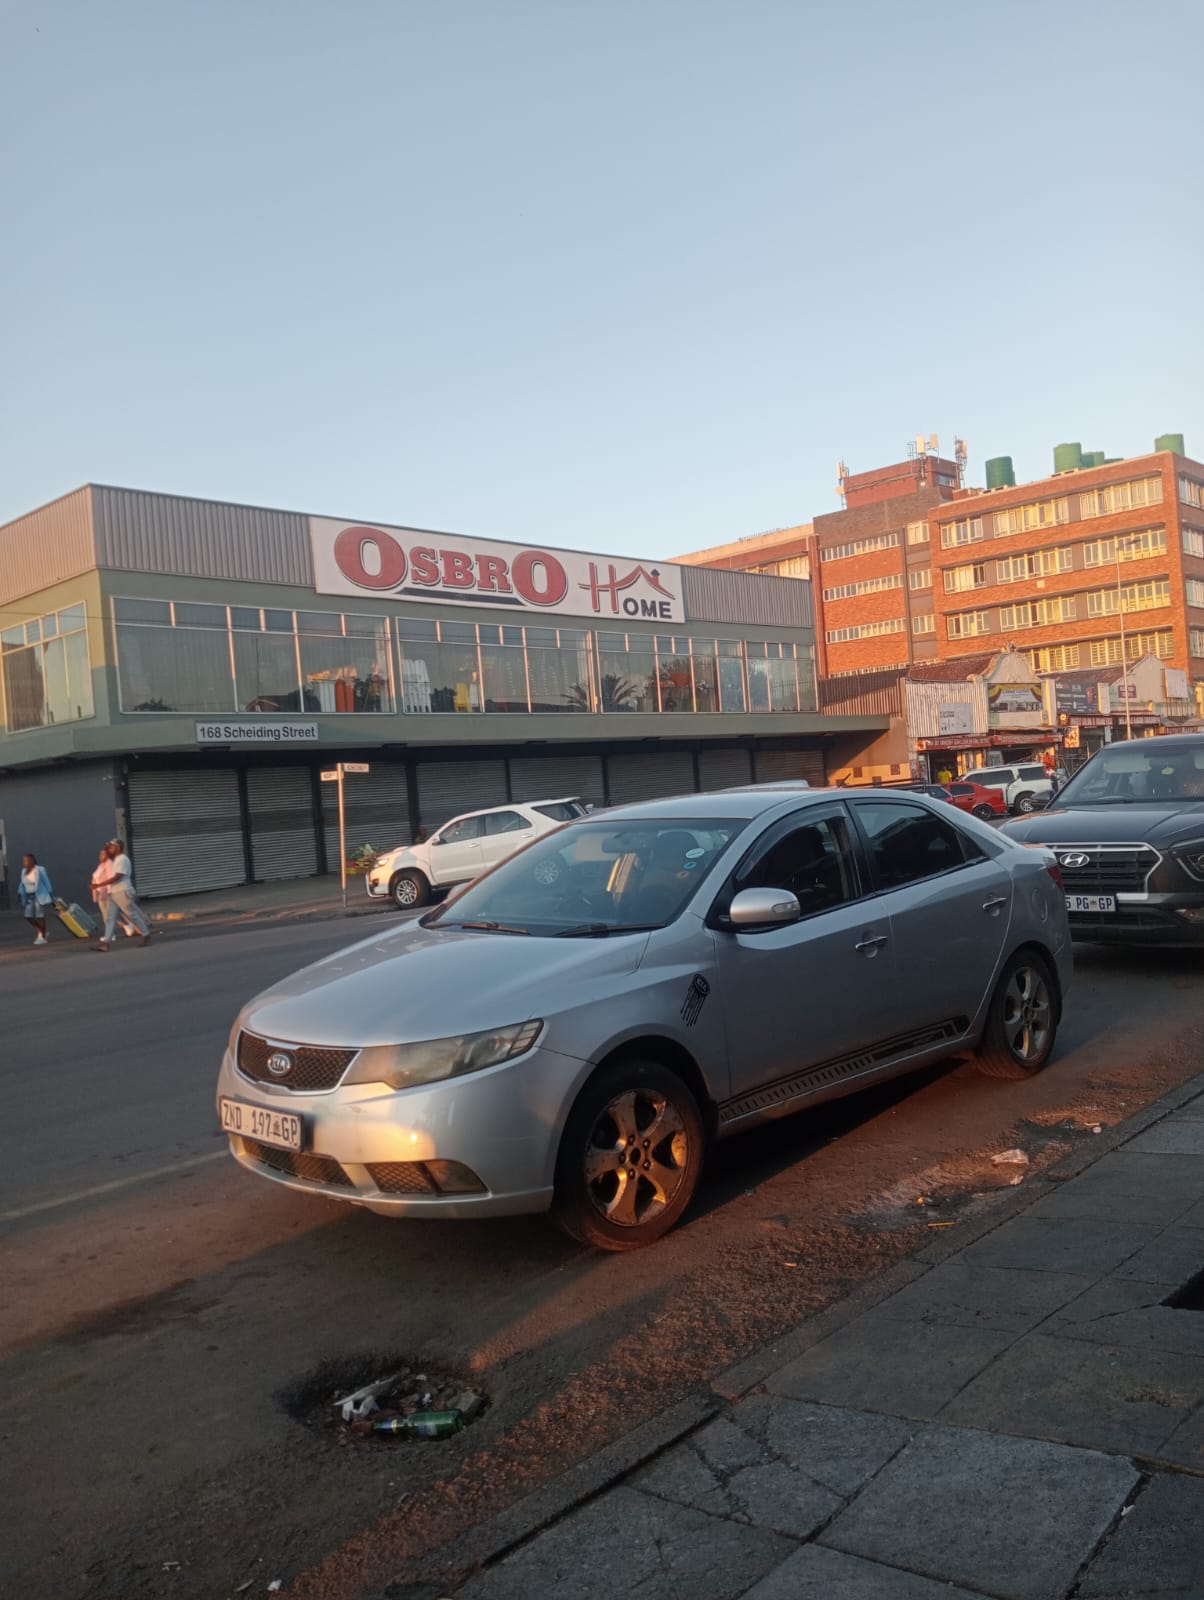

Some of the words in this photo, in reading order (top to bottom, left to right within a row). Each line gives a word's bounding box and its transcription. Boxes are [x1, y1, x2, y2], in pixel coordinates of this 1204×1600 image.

[334, 526, 568, 606] OSBRO
[200, 726, 221, 739] 168
[223, 726, 281, 741] Scheiding
[282, 726, 316, 738] Street
[1076, 896, 1090, 910] PG
[1098, 897, 1112, 910] GP
[272, 1057, 288, 1070] KIA
[223, 1103, 242, 1130] ZND
[252, 1109, 272, 1137] 197
[281, 1116, 298, 1143] GP
